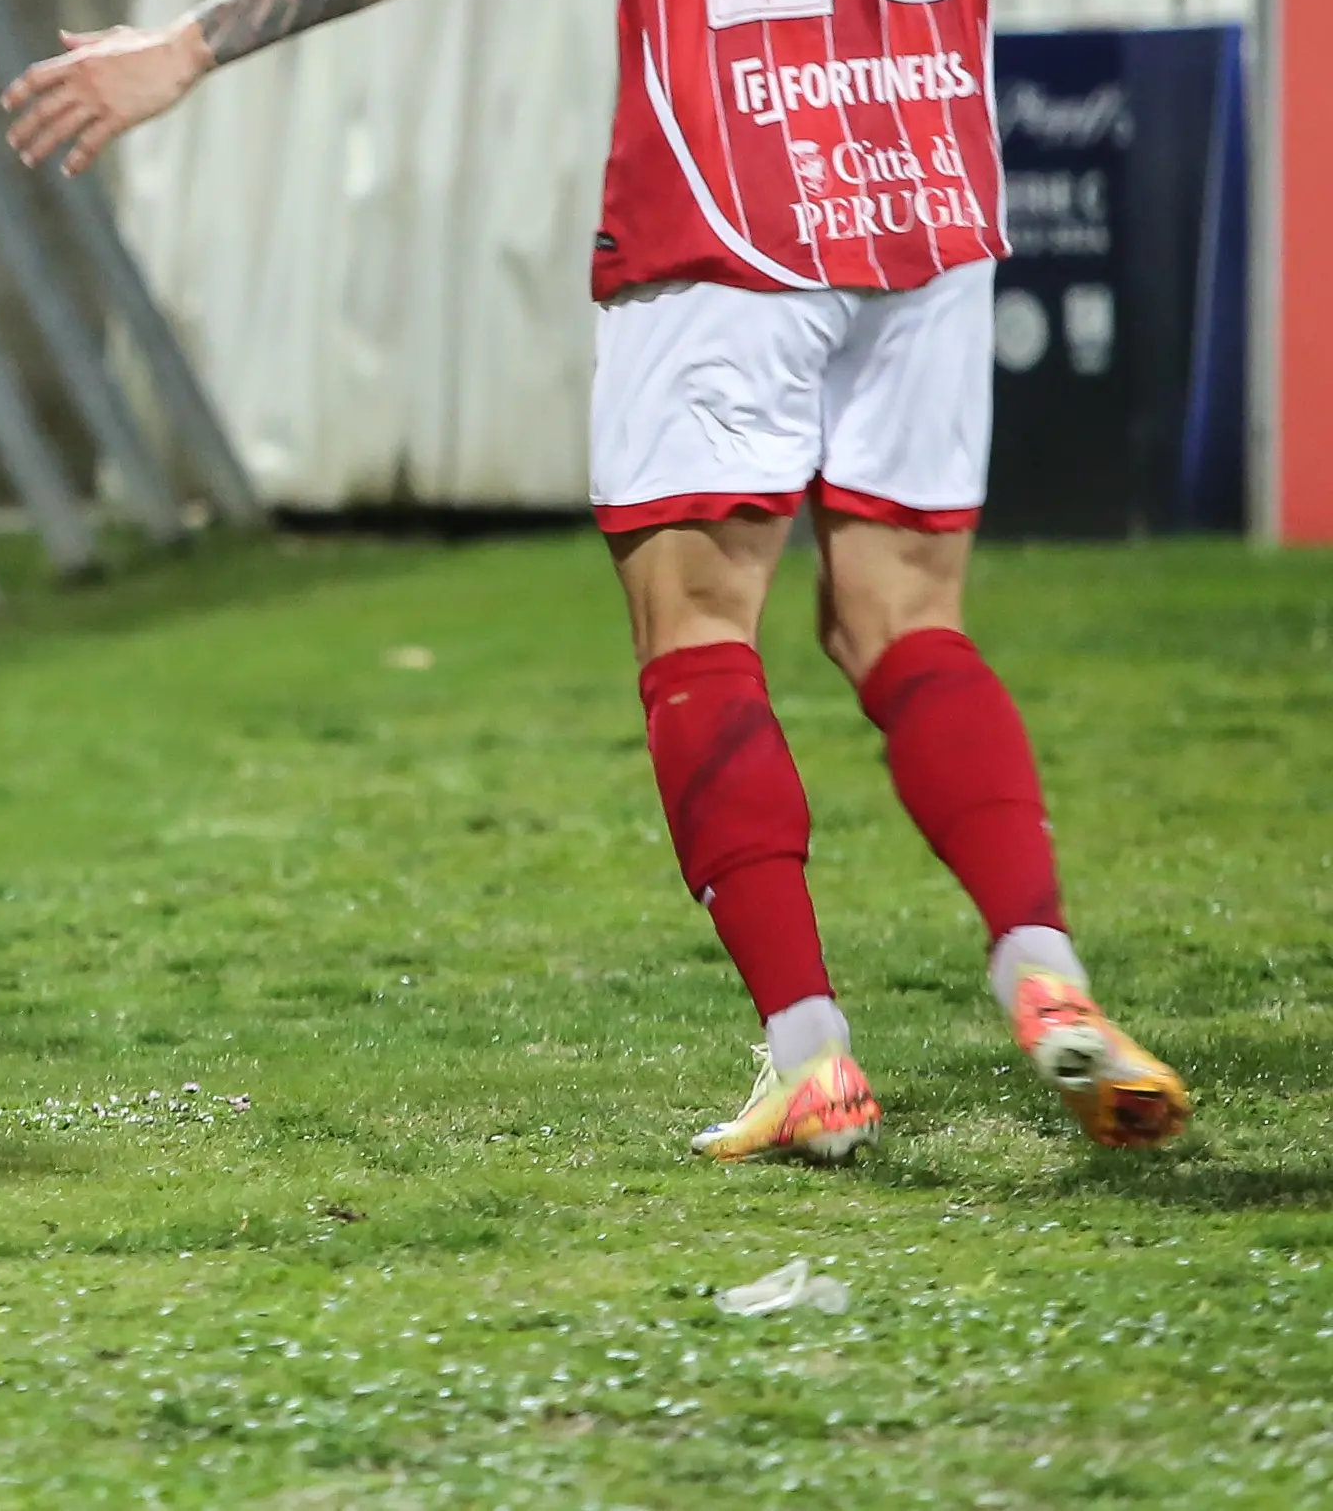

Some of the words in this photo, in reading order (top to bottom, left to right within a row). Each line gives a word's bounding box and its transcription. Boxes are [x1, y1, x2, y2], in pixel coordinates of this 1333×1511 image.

[779, 50, 982, 112] FORTINFISS
[930, 135, 968, 178] di
[790, 186, 989, 245] PERUGIA
